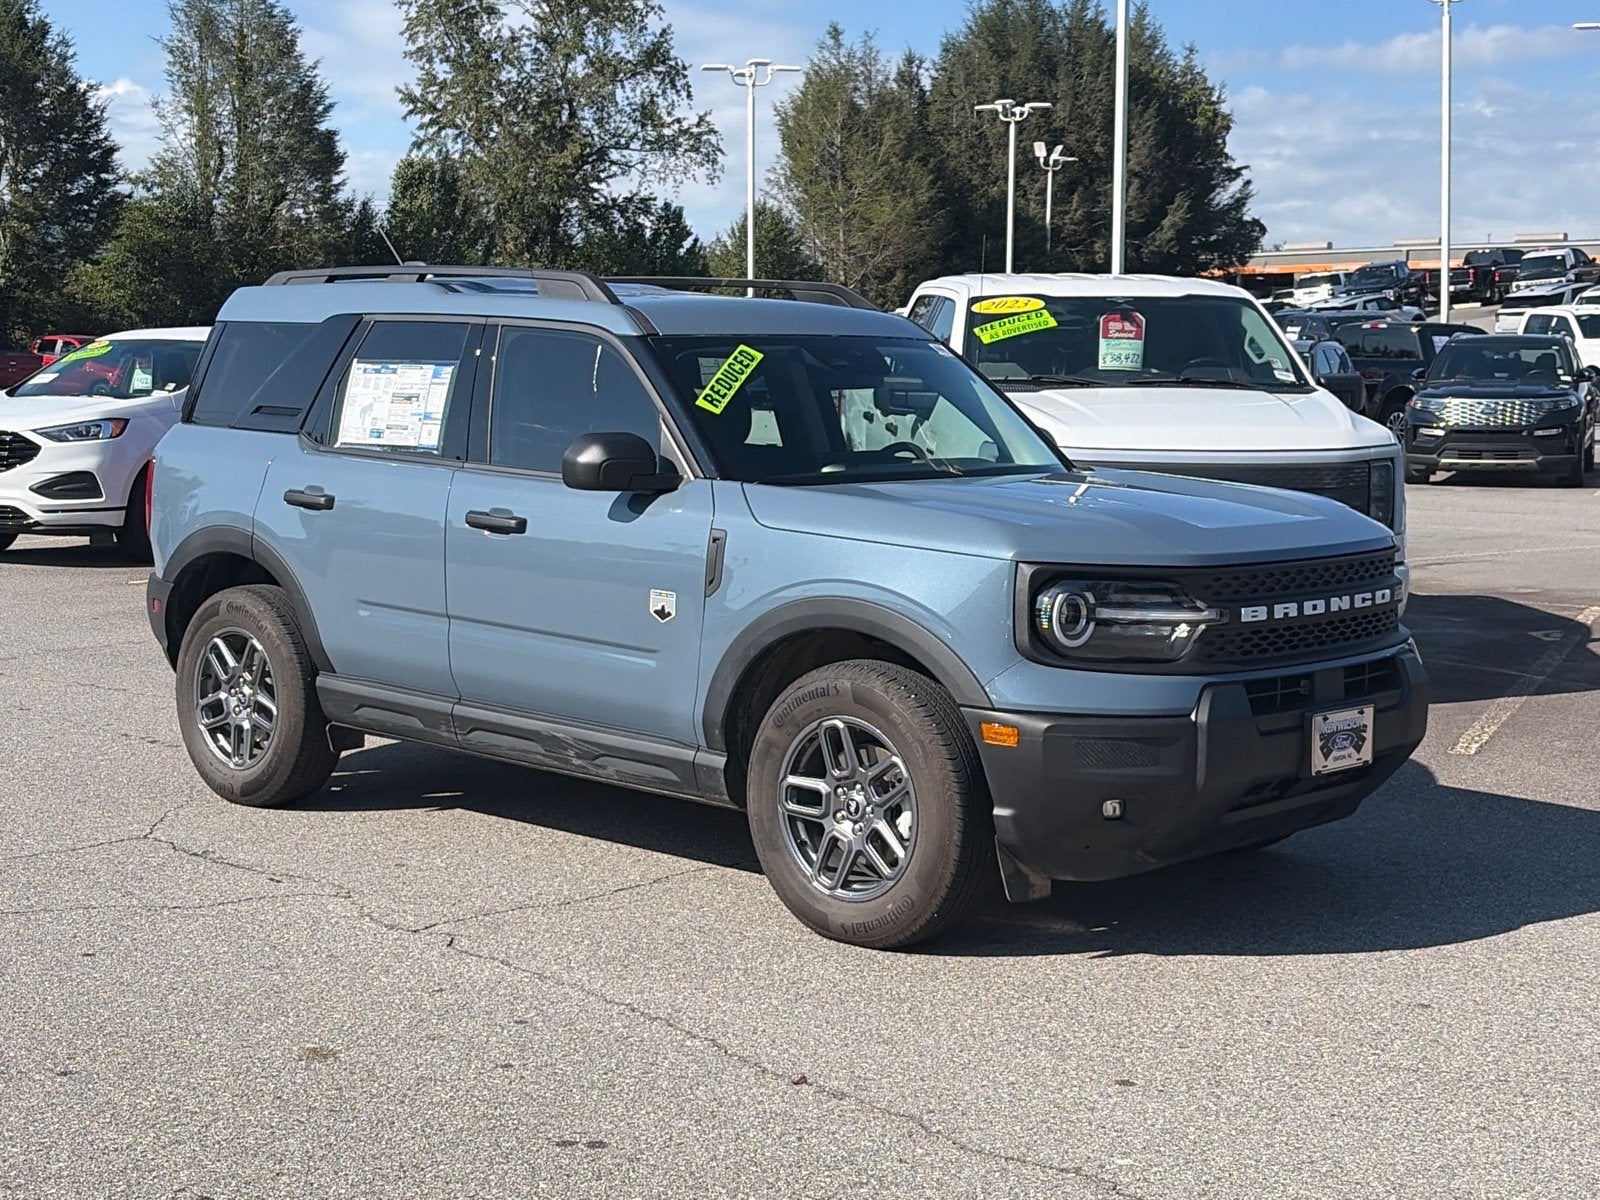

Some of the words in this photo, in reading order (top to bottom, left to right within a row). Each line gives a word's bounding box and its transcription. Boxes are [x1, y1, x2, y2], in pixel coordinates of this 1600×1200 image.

[983, 299, 1031, 311] 2023
[979, 311, 1044, 334] REDUCED
[989, 331, 1000, 341] AS
[1002, 320, 1049, 336] ADVERTISED
[701, 349, 756, 409] REDUCED
[226, 601, 268, 632] Continental
[1241, 589, 1391, 622] BRONCO
[773, 683, 830, 727] Continental
[1333, 733, 1352, 749] Ford
[850, 894, 915, 935] Continental
